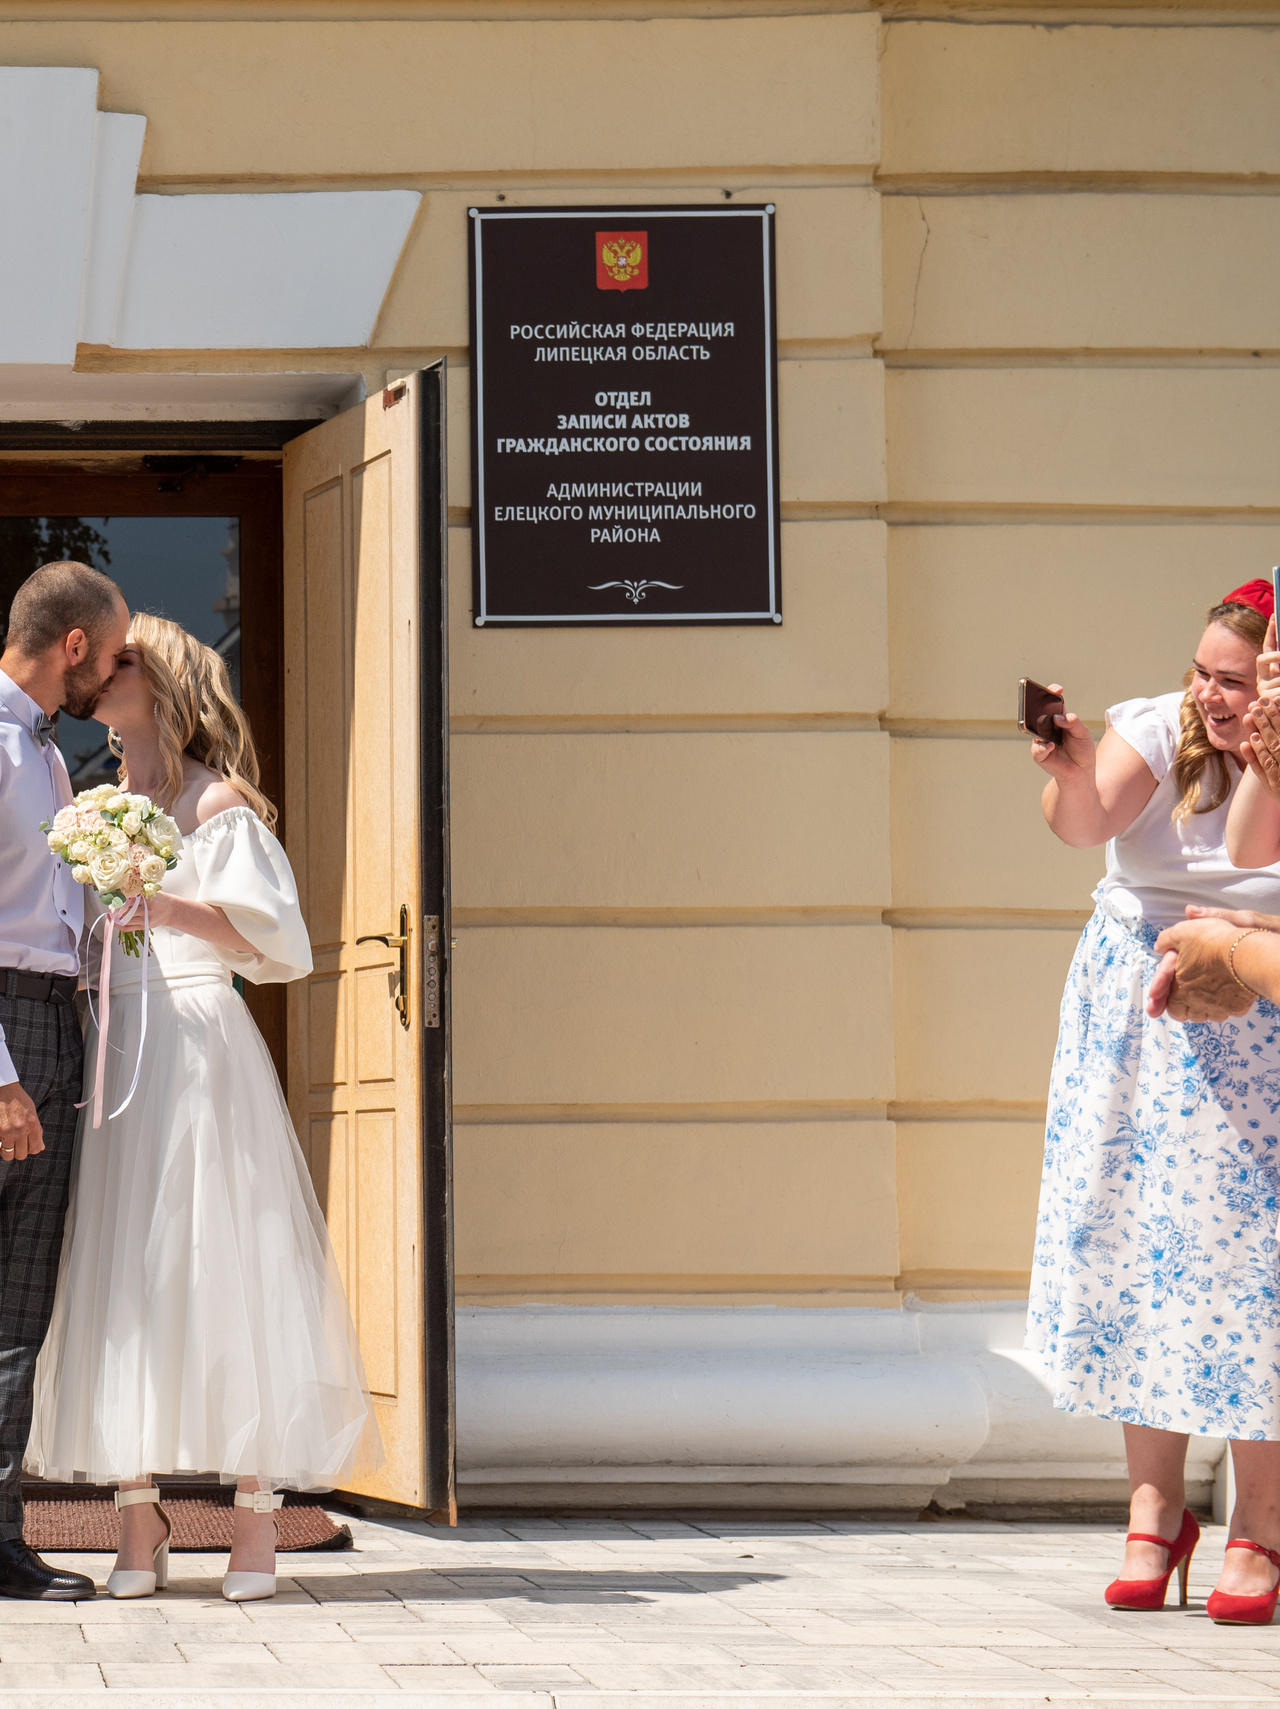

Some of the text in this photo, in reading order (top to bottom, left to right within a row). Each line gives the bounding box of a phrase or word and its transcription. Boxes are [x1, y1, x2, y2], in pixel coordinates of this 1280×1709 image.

[510, 321, 735, 341] РОССИЙСКАЯ ФЕДЕРАЦИЯ
[534, 345, 711, 364] ЛИПЕЦКАЯ ОБЛАСТЬ
[594, 391, 652, 409] ОТДЕЛ
[556, 413, 690, 430] ЗАПИСИ АКТОВ
[496, 435, 752, 456] ГРАЖДАНСКОГО СОСТОЯНИЯ
[546, 481, 703, 501] АДМИНИСТРАЦИИ
[494, 503, 756, 524] ЕЛЕЦКОГО МУНИЦИПАЛЬНОГО
[590, 525, 661, 543] РАЙОНА
